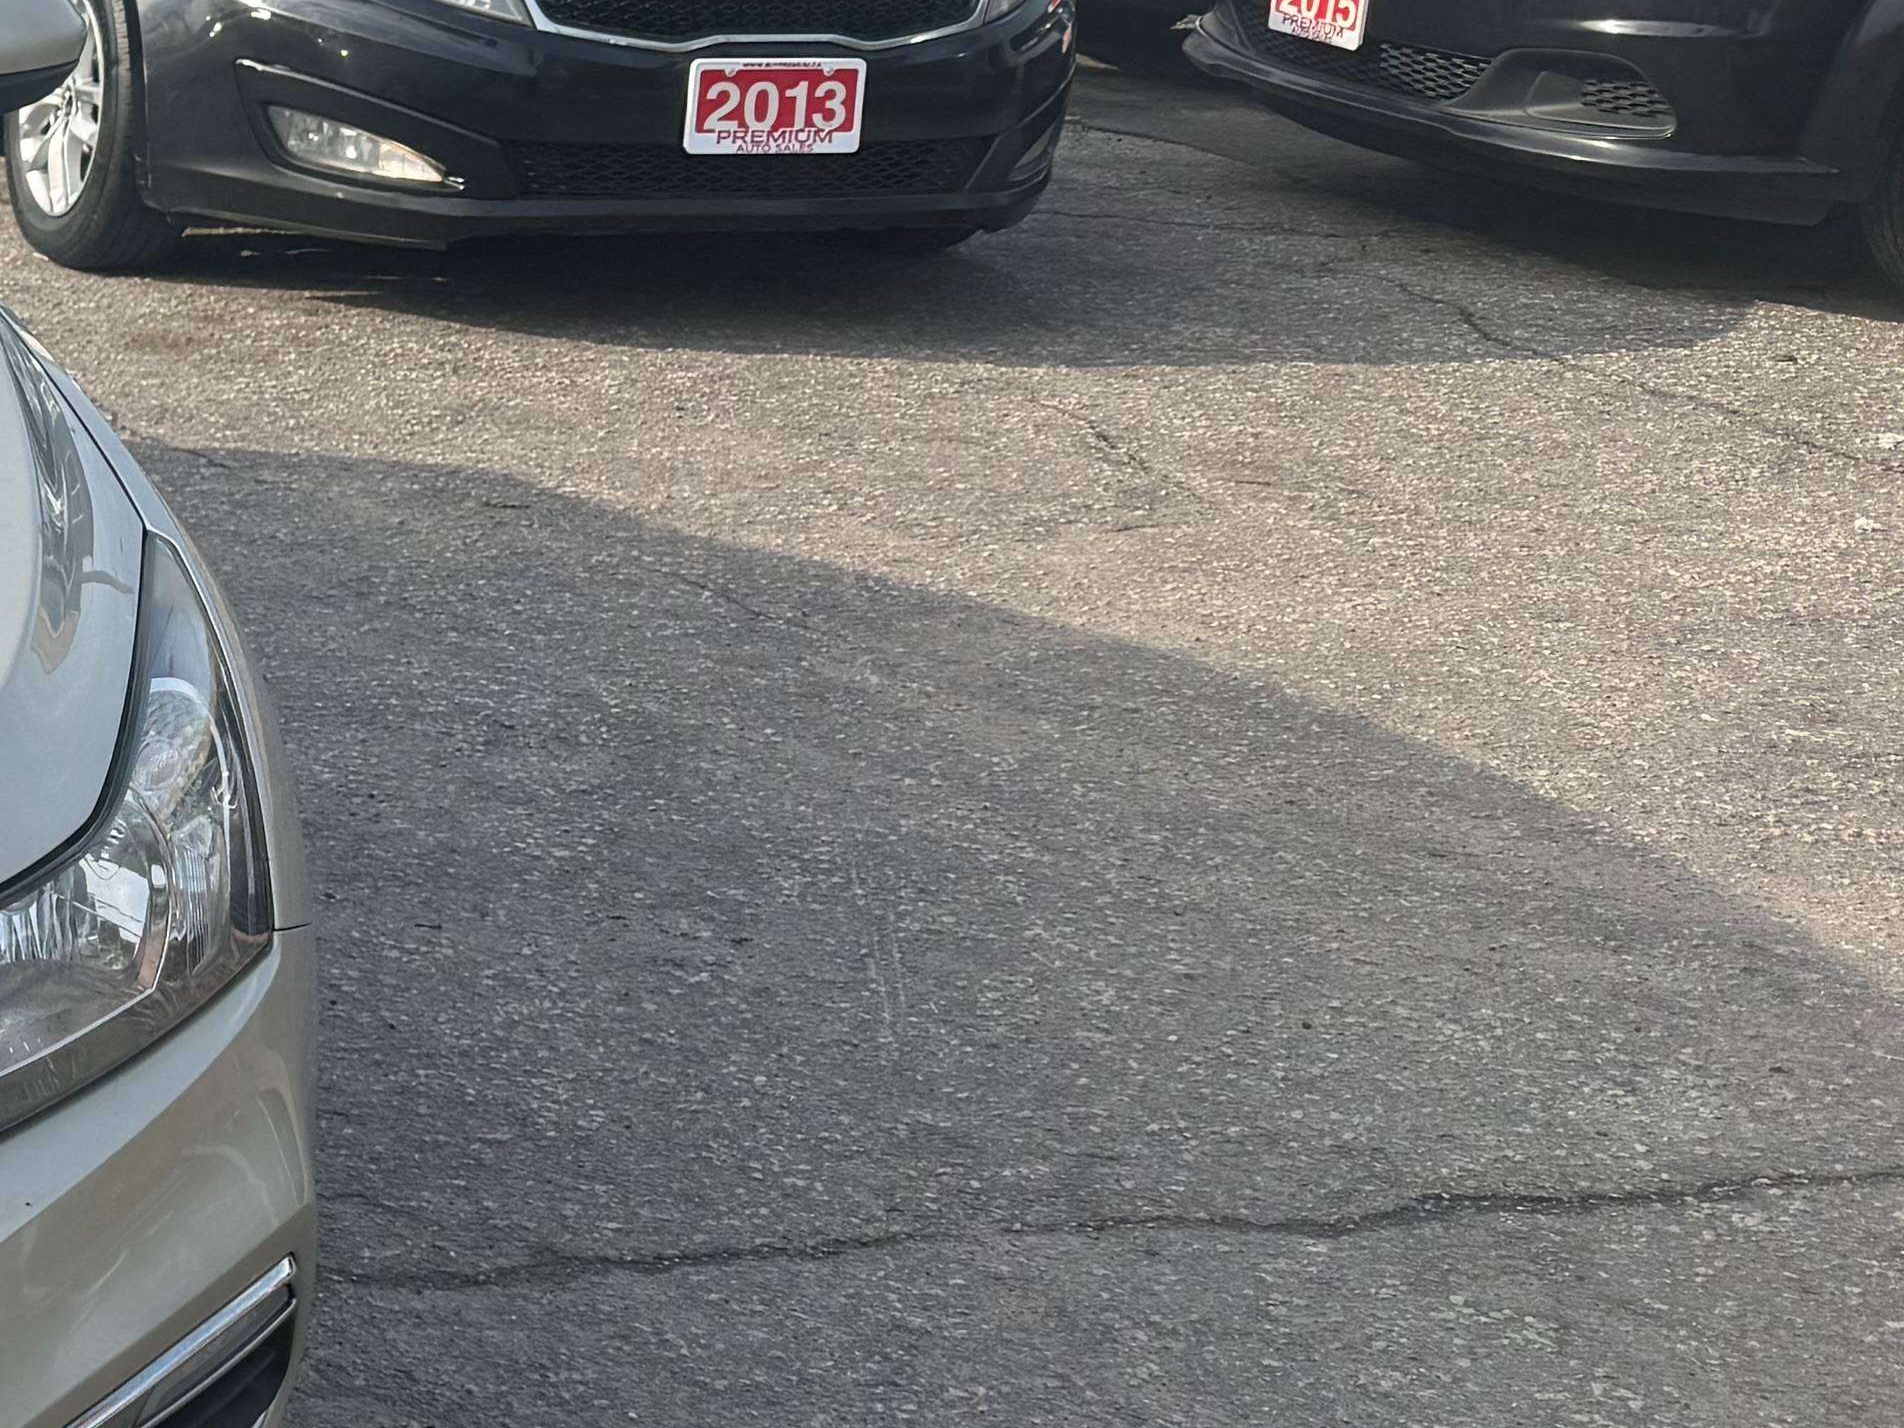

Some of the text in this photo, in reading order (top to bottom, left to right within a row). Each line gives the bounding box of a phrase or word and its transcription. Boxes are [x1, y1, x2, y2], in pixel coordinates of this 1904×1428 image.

[703, 80, 847, 131] 2013
[716, 128, 833, 145] PREMIUM
[736, 143, 814, 154] AUTO SALES
